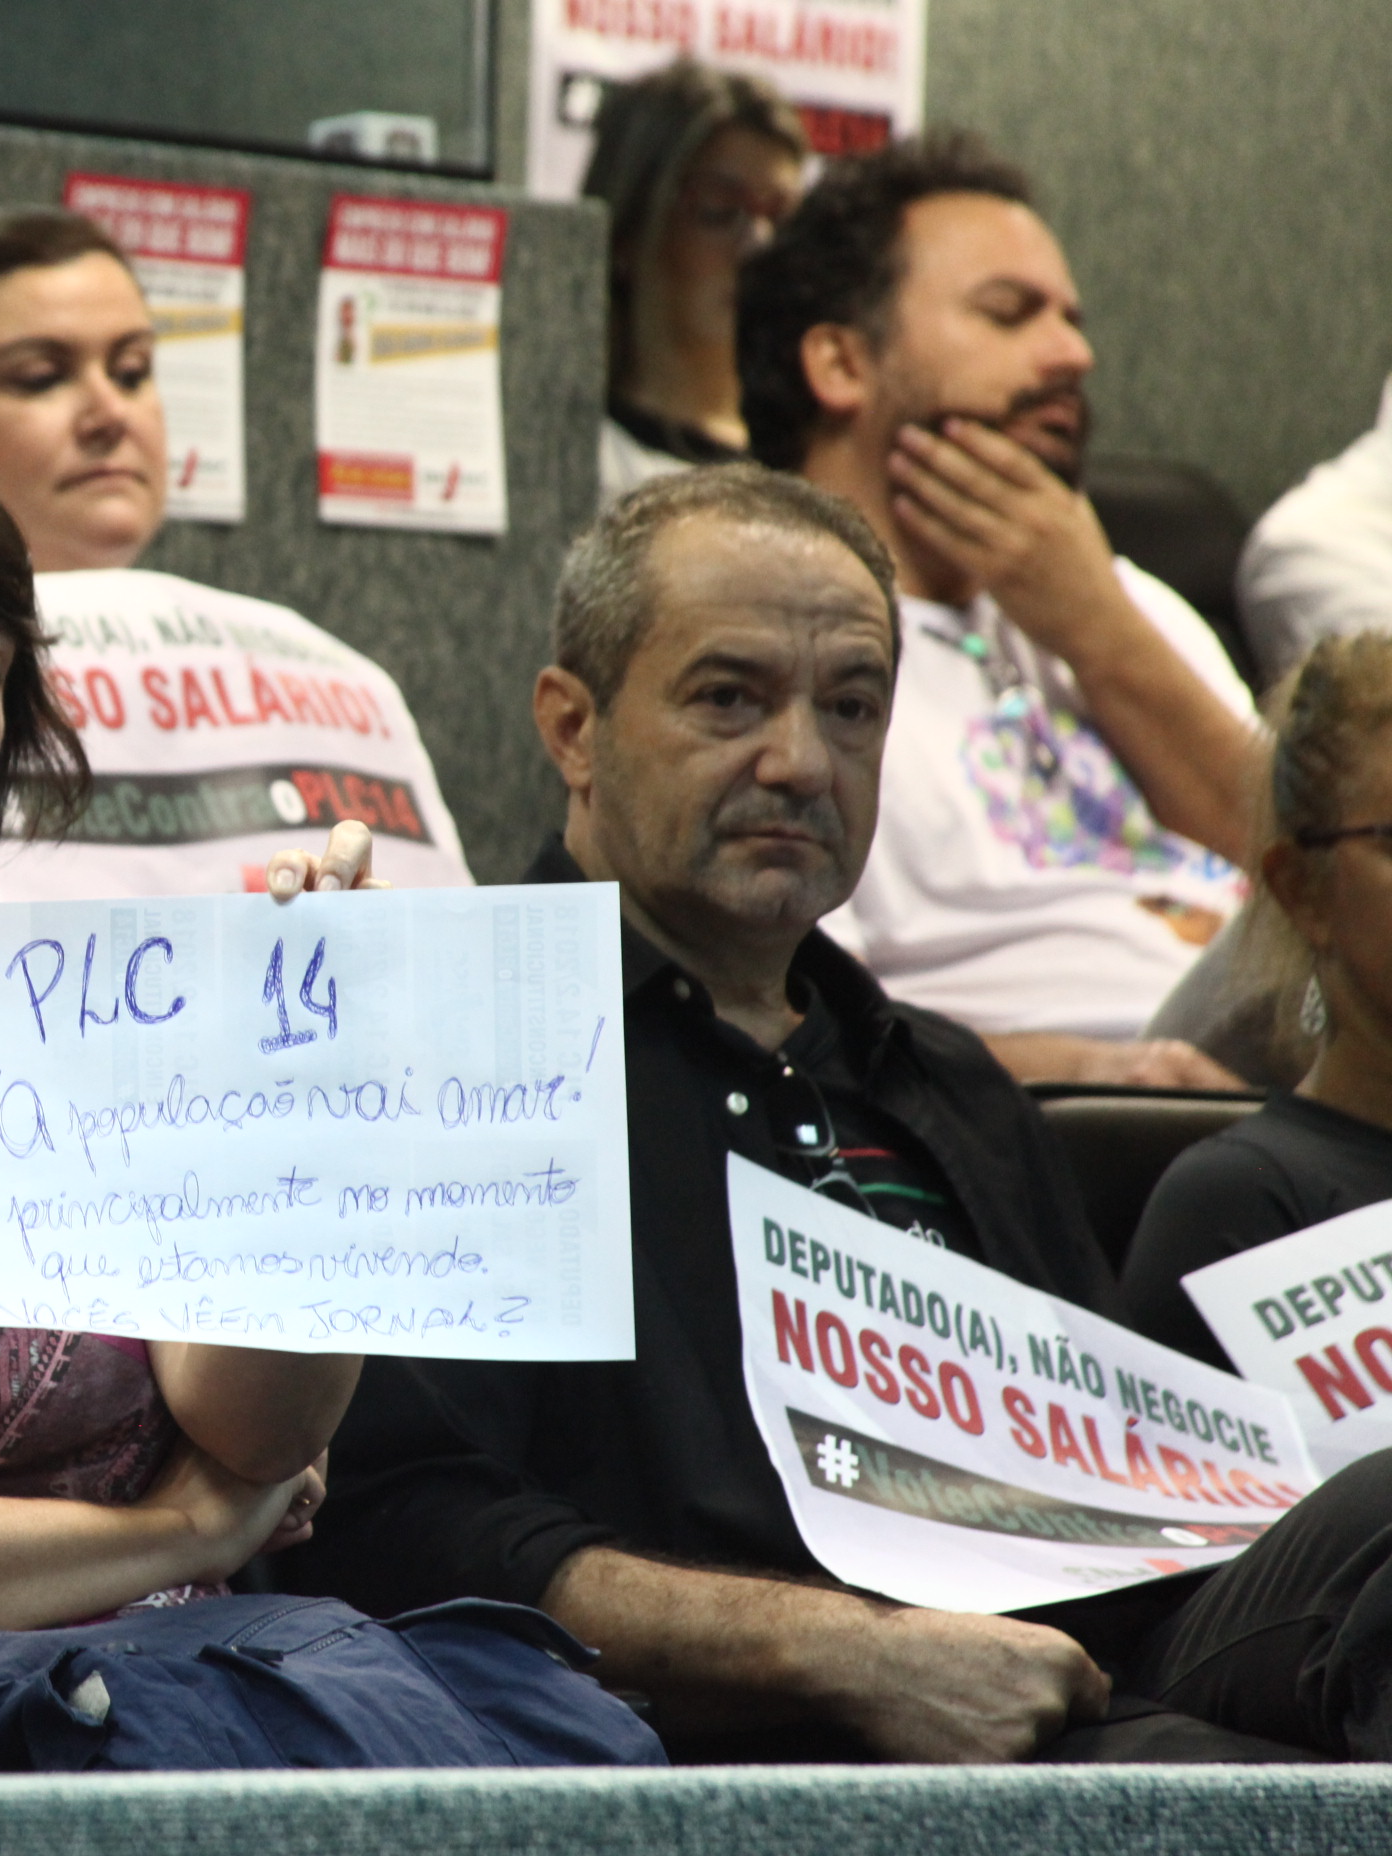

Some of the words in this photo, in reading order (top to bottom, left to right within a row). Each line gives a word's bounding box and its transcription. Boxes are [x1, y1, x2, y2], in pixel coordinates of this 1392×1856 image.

[141, 652, 392, 740] SALÁRIO!
[6, 932, 186, 1043] PLC
[258, 936, 338, 1053] 14
[308, 1066, 422, 1122] vai
[7, 1165, 322, 1266] principalmente
[339, 1184, 390, 1219] no
[405, 1157, 582, 1217] momento
[41, 1251, 120, 1304] que
[137, 1241, 303, 1289] estamos
[763, 1216, 1019, 1373] DEPUTADO(A),
[1027, 1330, 1107, 1400] NÃO
[1115, 1368, 1279, 1466] NEGOCIE
[771, 1289, 985, 1437] NOSSO
[816, 1434, 1272, 1547] #VoteContraoPL
